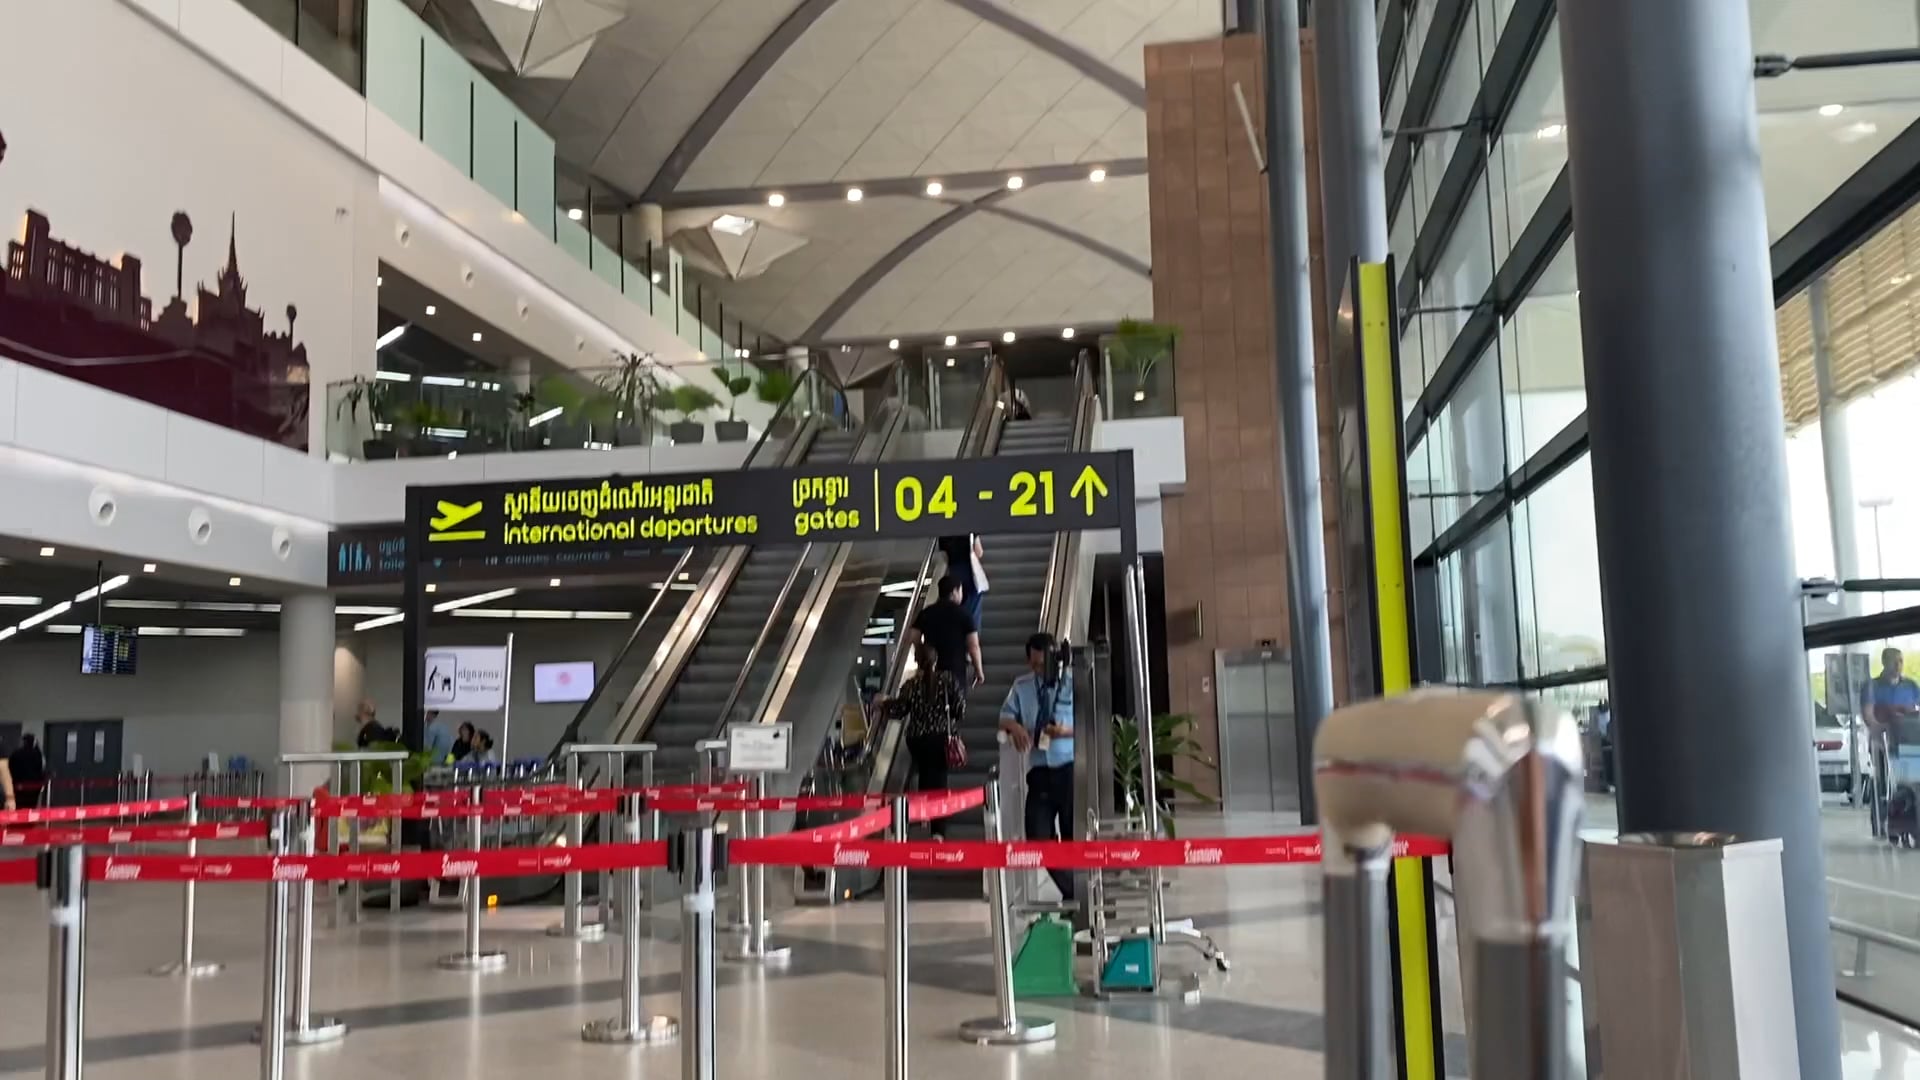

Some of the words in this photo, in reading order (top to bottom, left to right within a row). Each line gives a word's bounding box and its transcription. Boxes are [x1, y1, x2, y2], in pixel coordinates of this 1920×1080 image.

[895, 475, 959, 522] 04
[978, 490, 994, 500] -
[1009, 470, 1054, 517] 21
[639, 513, 759, 542] departures
[795, 507, 861, 537] gates
